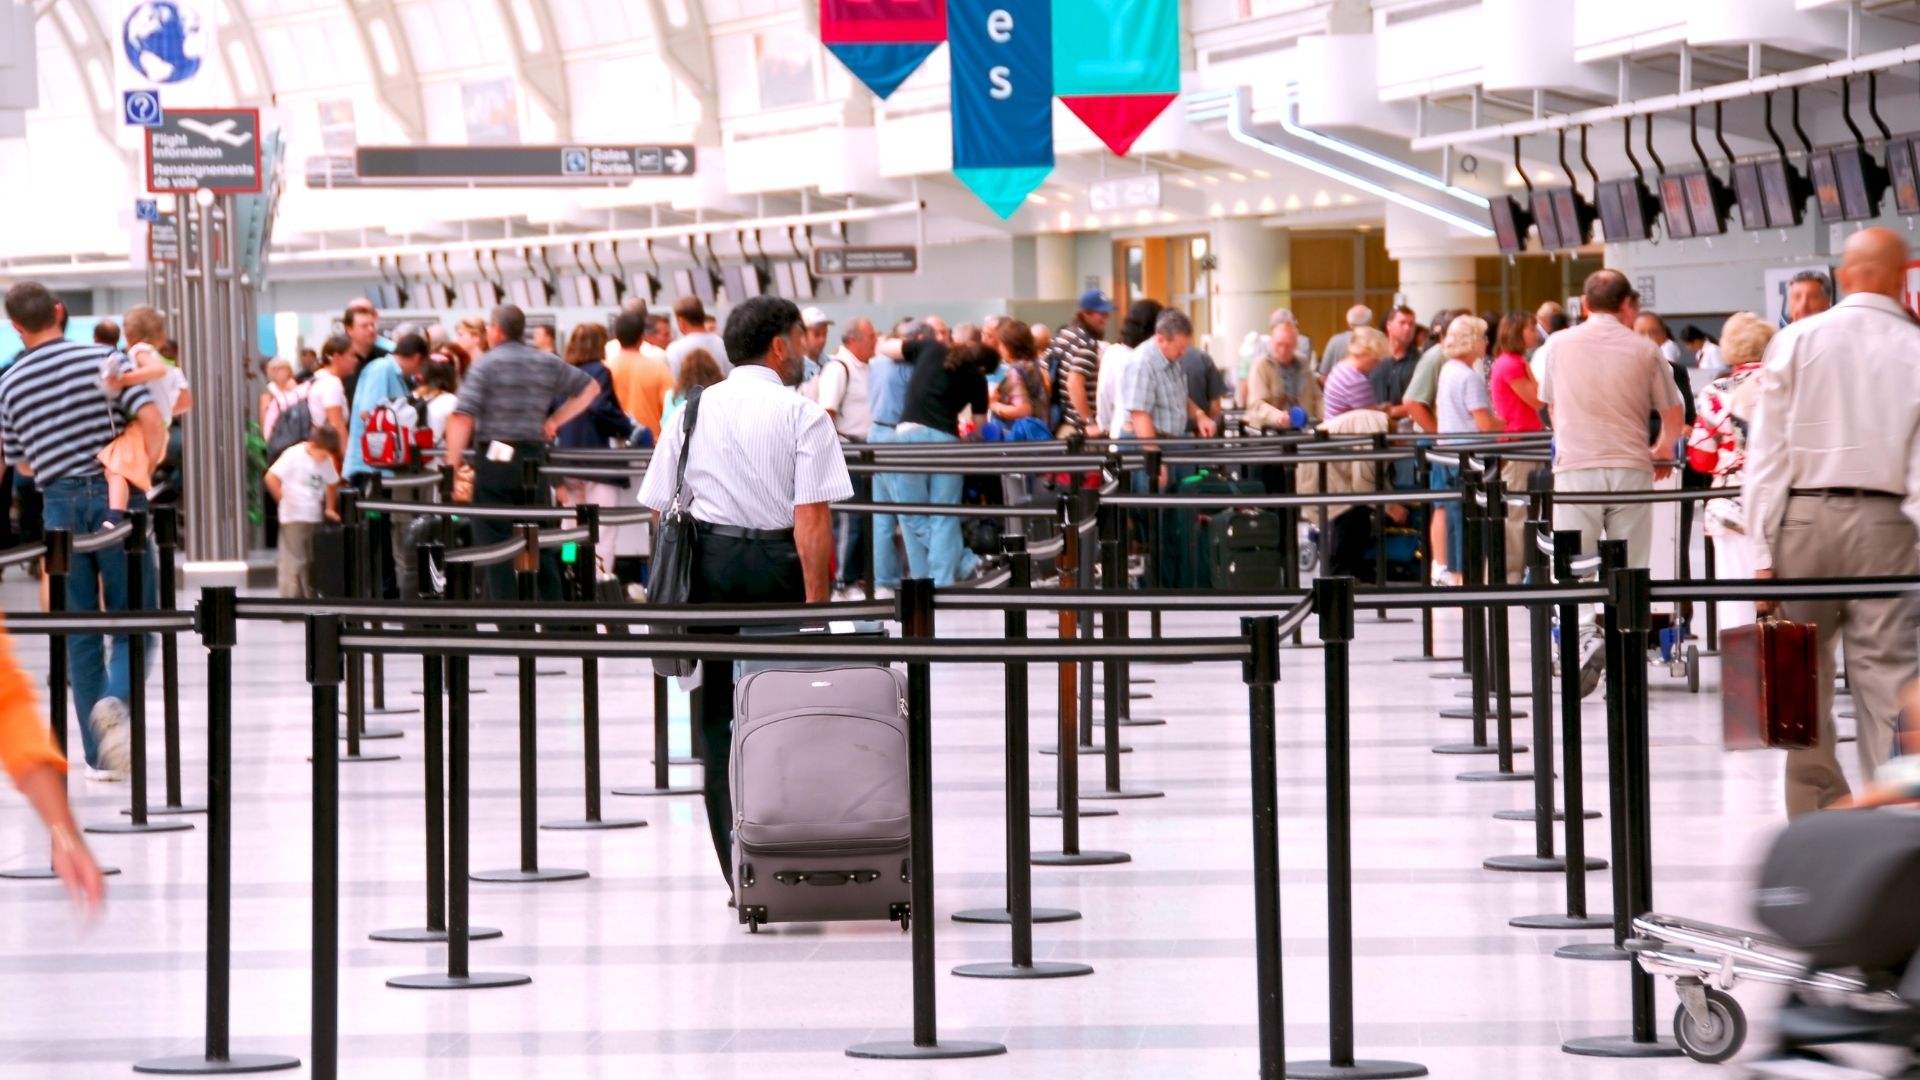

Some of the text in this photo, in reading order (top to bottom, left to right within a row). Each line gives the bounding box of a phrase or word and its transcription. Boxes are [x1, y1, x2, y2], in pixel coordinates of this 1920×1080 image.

[152, 133, 188, 147] Flight
[152, 145, 224, 158] Information
[153, 163, 255, 178] Renseignements
[153, 176, 198, 187] de vols
